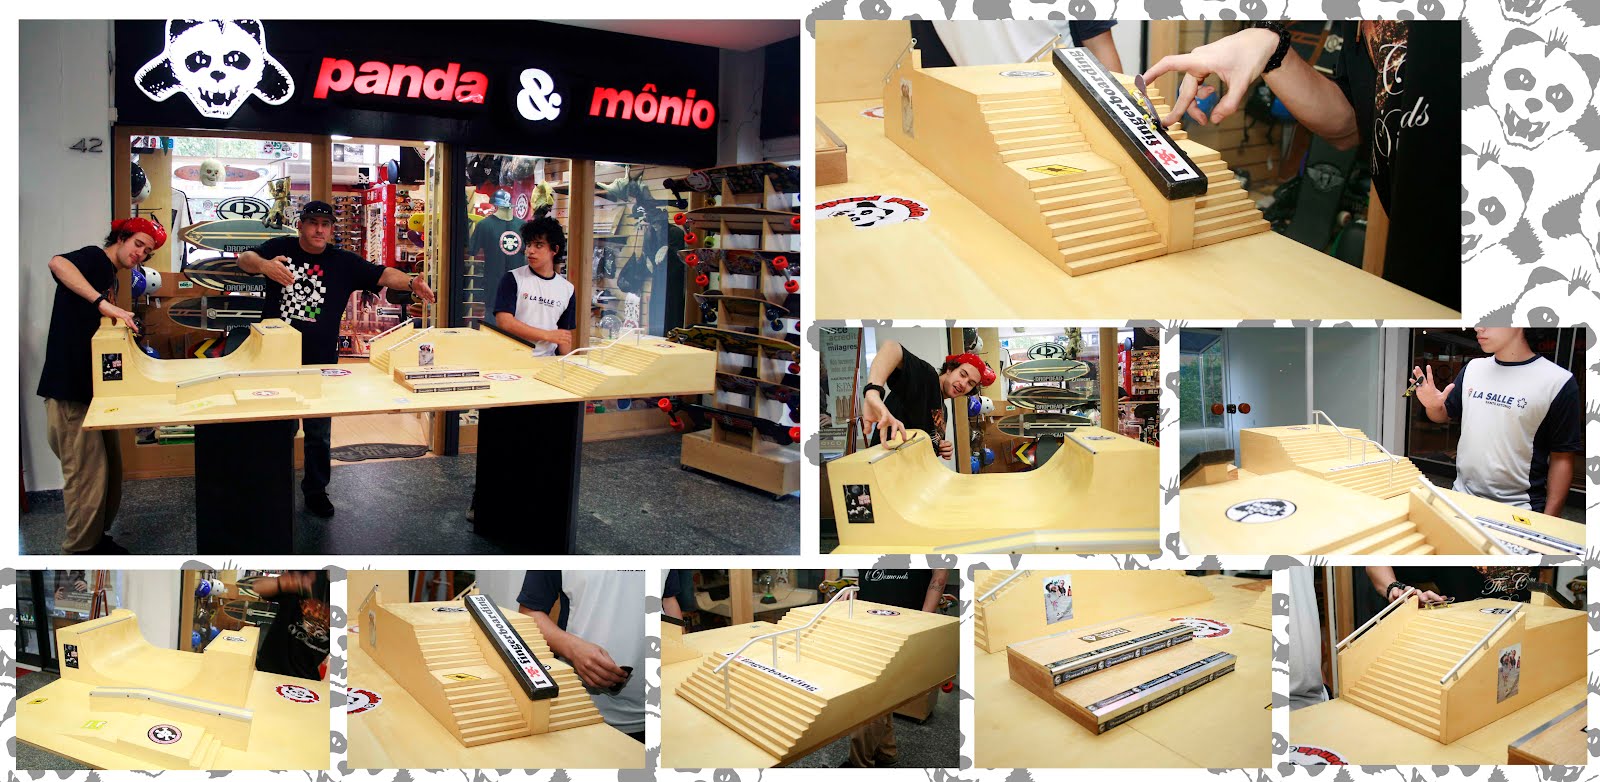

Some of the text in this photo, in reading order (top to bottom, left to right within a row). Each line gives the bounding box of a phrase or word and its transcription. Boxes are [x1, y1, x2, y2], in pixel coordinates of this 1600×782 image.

[313, 57, 716, 130] panda & mônio
[70, 137, 103, 153] 42
[829, 333, 857, 341] acredit
[1473, 391, 1515, 405] LA SALLE
